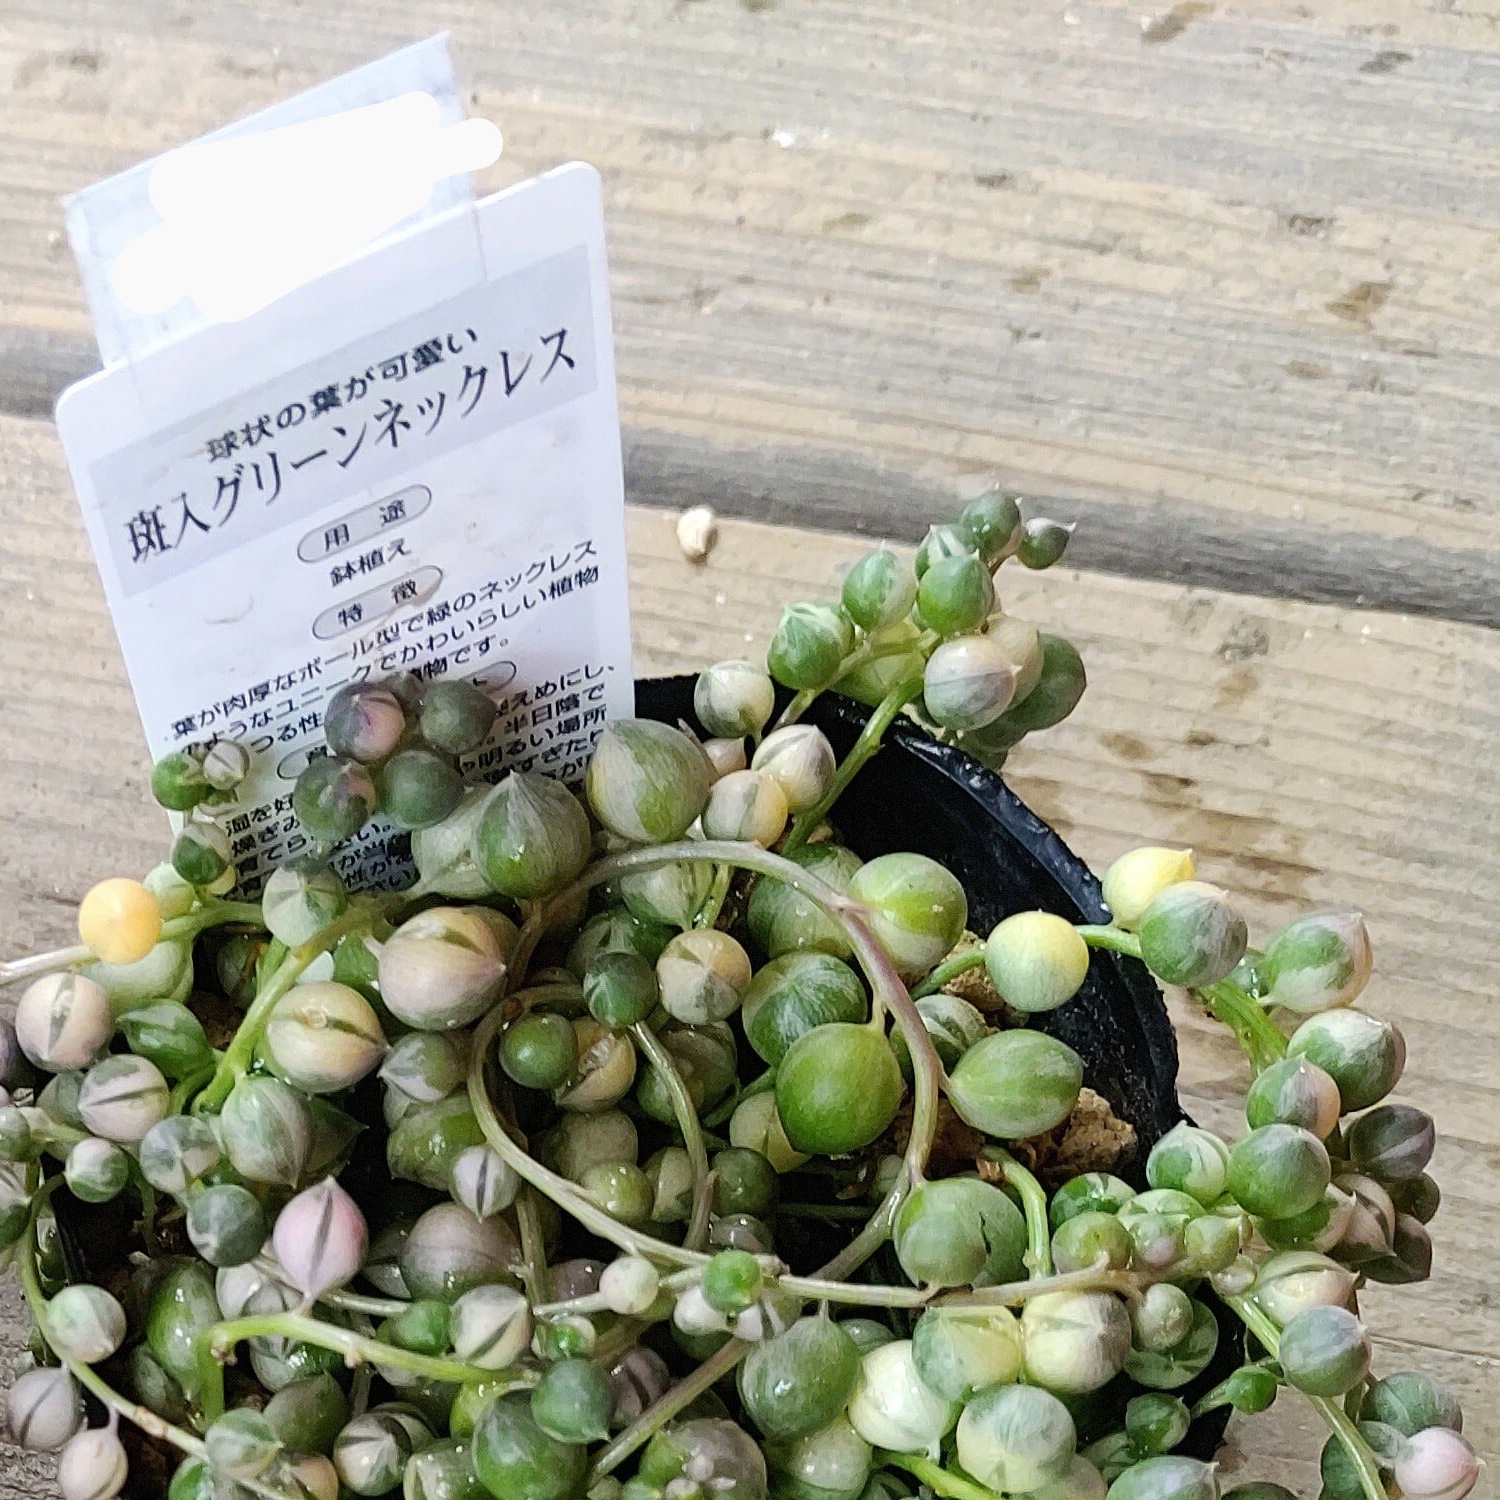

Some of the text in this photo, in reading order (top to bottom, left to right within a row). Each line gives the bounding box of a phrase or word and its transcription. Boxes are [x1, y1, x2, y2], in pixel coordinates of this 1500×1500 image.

[123, 328, 576, 564] 斑入グリーンネックレス
[204, 327, 479, 463] 球状の葉が可愛い
[329, 537, 412, 588] 鉢植え
